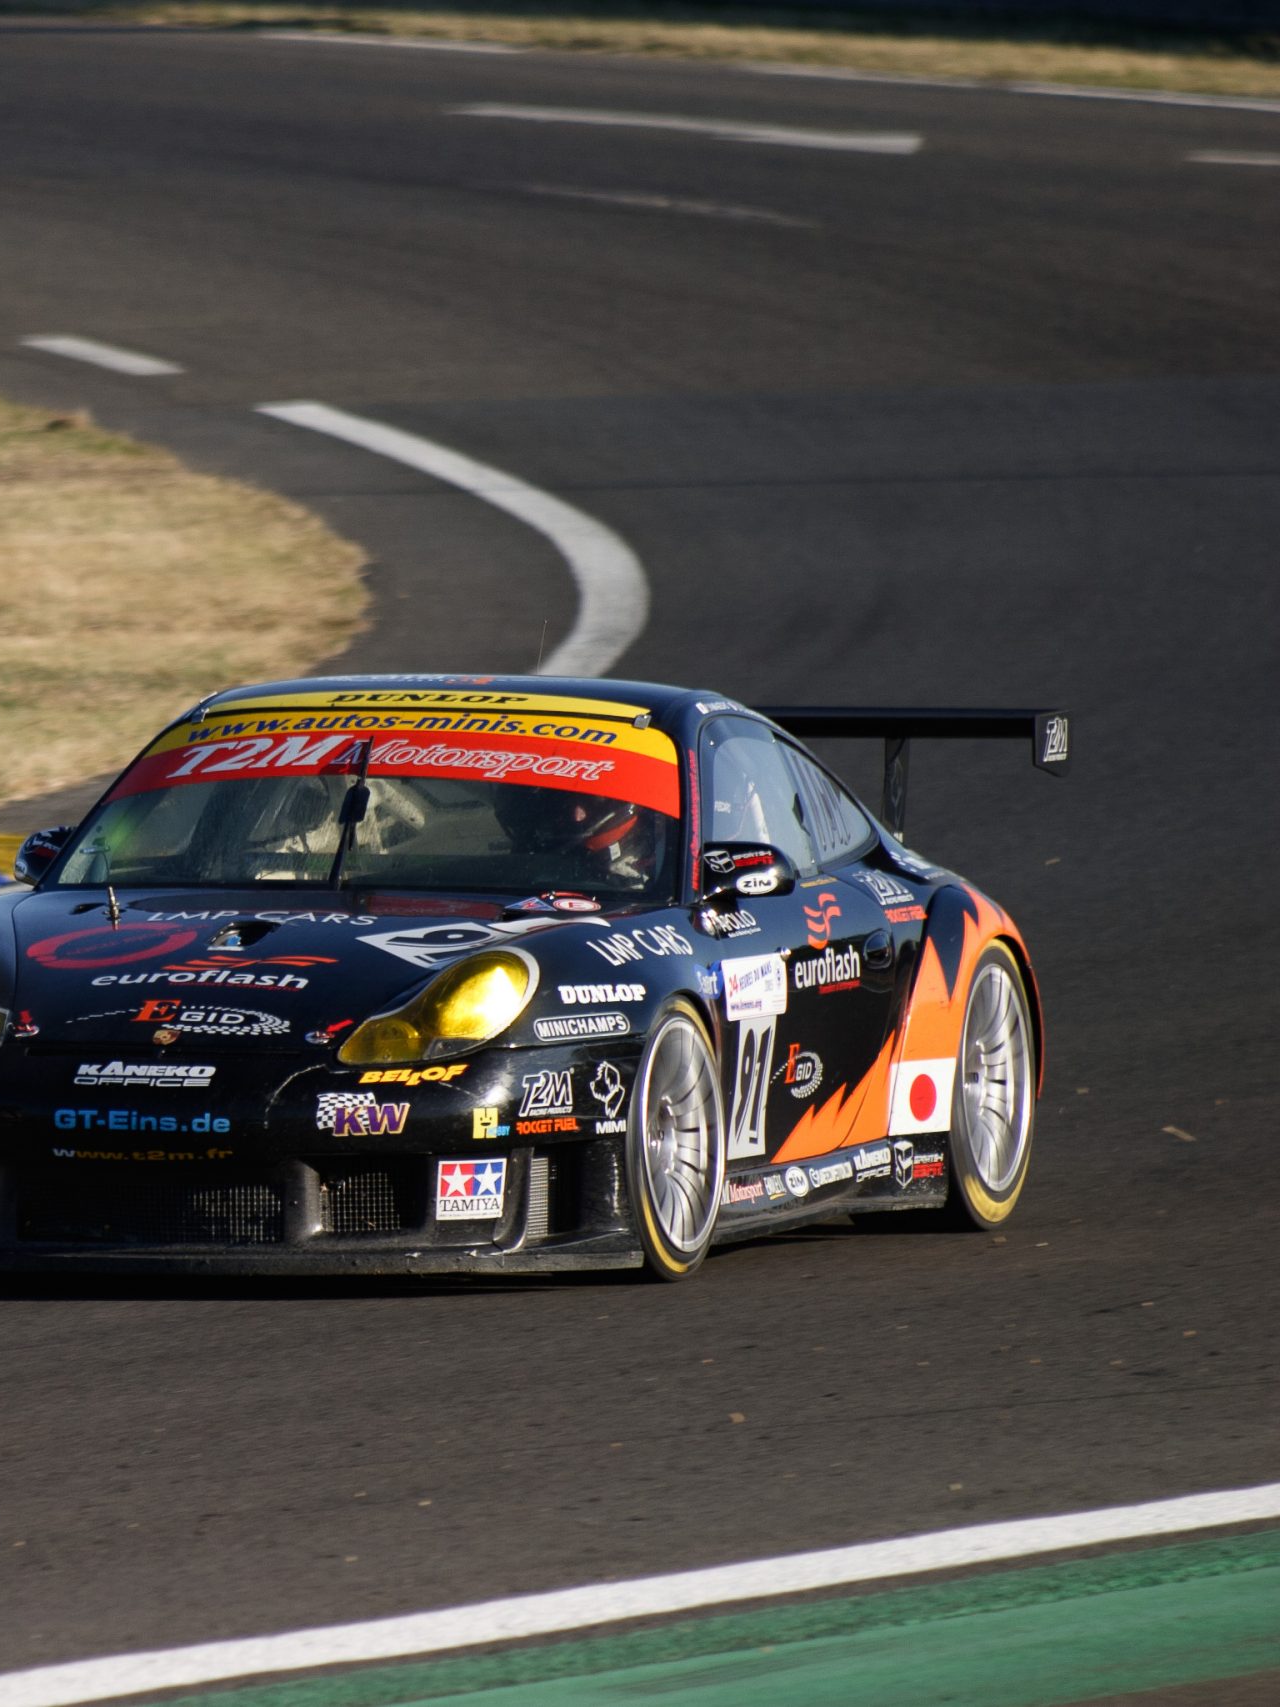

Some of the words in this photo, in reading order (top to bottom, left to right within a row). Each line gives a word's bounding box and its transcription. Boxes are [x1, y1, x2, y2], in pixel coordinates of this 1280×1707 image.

[327, 692, 530, 705] DUNLOP
[187, 712, 618, 745] www.autos-minis.com
[165, 734, 354, 779] T2M
[330, 738, 616, 781] Motorsport
[147, 909, 240, 922] LMP
[254, 910, 379, 926] CARS
[586, 933, 645, 967] LMP
[633, 924, 694, 956] CARS
[794, 944, 861, 989] euroflash
[91, 970, 310, 989] euroflash
[558, 984, 647, 1005] DUNLOP
[538, 1015, 627, 1038] MINICHAMPS
[73, 1076, 212, 1087] OFFICE
[358, 1064, 469, 1086] BELLOF
[734, 1025, 772, 1145] 91
[518, 1069, 574, 1117] T2M
[53, 1108, 232, 1133] GT-Eins.de
[332, 1102, 411, 1137] KW
[553, 1116, 579, 1133] FUEL
[595, 1120, 627, 1134] MIMI
[52, 1147, 234, 1161] www.t2m.fr
[439, 1197, 501, 1212] TAMIYA
